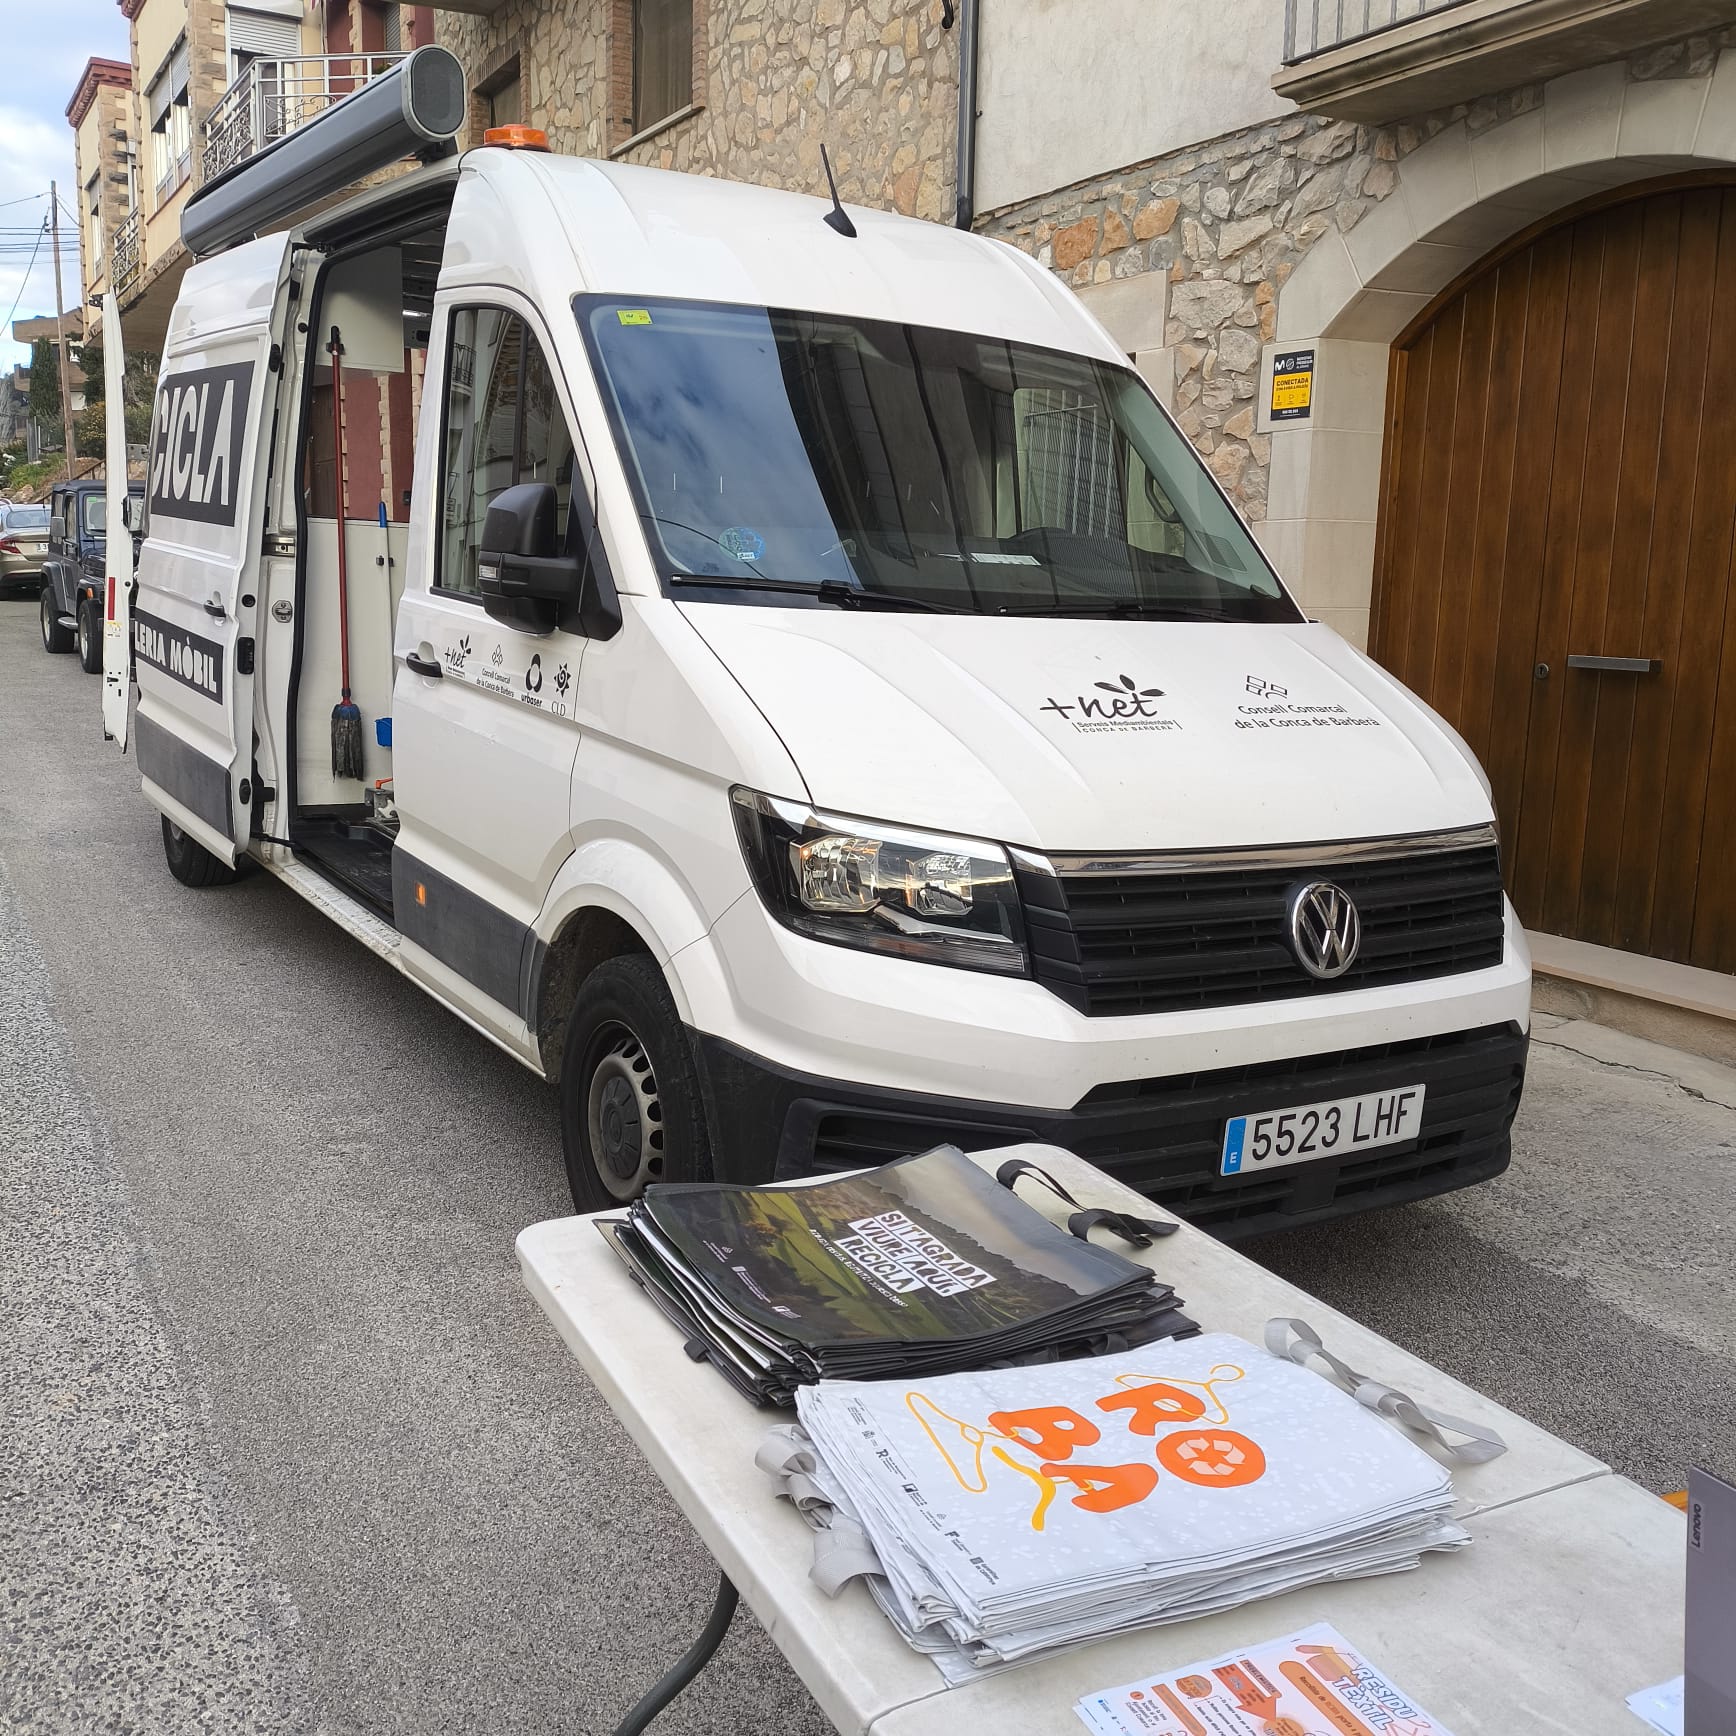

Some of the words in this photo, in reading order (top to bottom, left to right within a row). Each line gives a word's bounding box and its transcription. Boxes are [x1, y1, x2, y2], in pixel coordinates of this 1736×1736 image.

[1276, 377, 1309, 386] CONECTADA
[151, 379, 235, 506] CICLA
[170, 635, 217, 694] MÒBIL
[521, 692, 543, 707] urbaser
[1237, 704, 1289, 714] Consell
[1287, 704, 1348, 713] Comarcal
[1234, 718, 1254, 729] de
[1251, 718, 1270, 728] la
[1268, 718, 1313, 728] Conca
[1311, 716, 1331, 726] de
[1251, 1106, 1341, 1161] 5523
[1352, 1091, 1417, 1143] LHF
[1229, 1152, 1237, 1164] E
[857, 1220, 916, 1258] VIURE
[880, 1212, 909, 1228] SI
[899, 1225, 988, 1287] T'AGRADA
[840, 1238, 915, 1290] RECICLA
[1691, 1503, 1702, 1548] Lenovo
[1350, 1668, 1418, 1720] RESIDU
